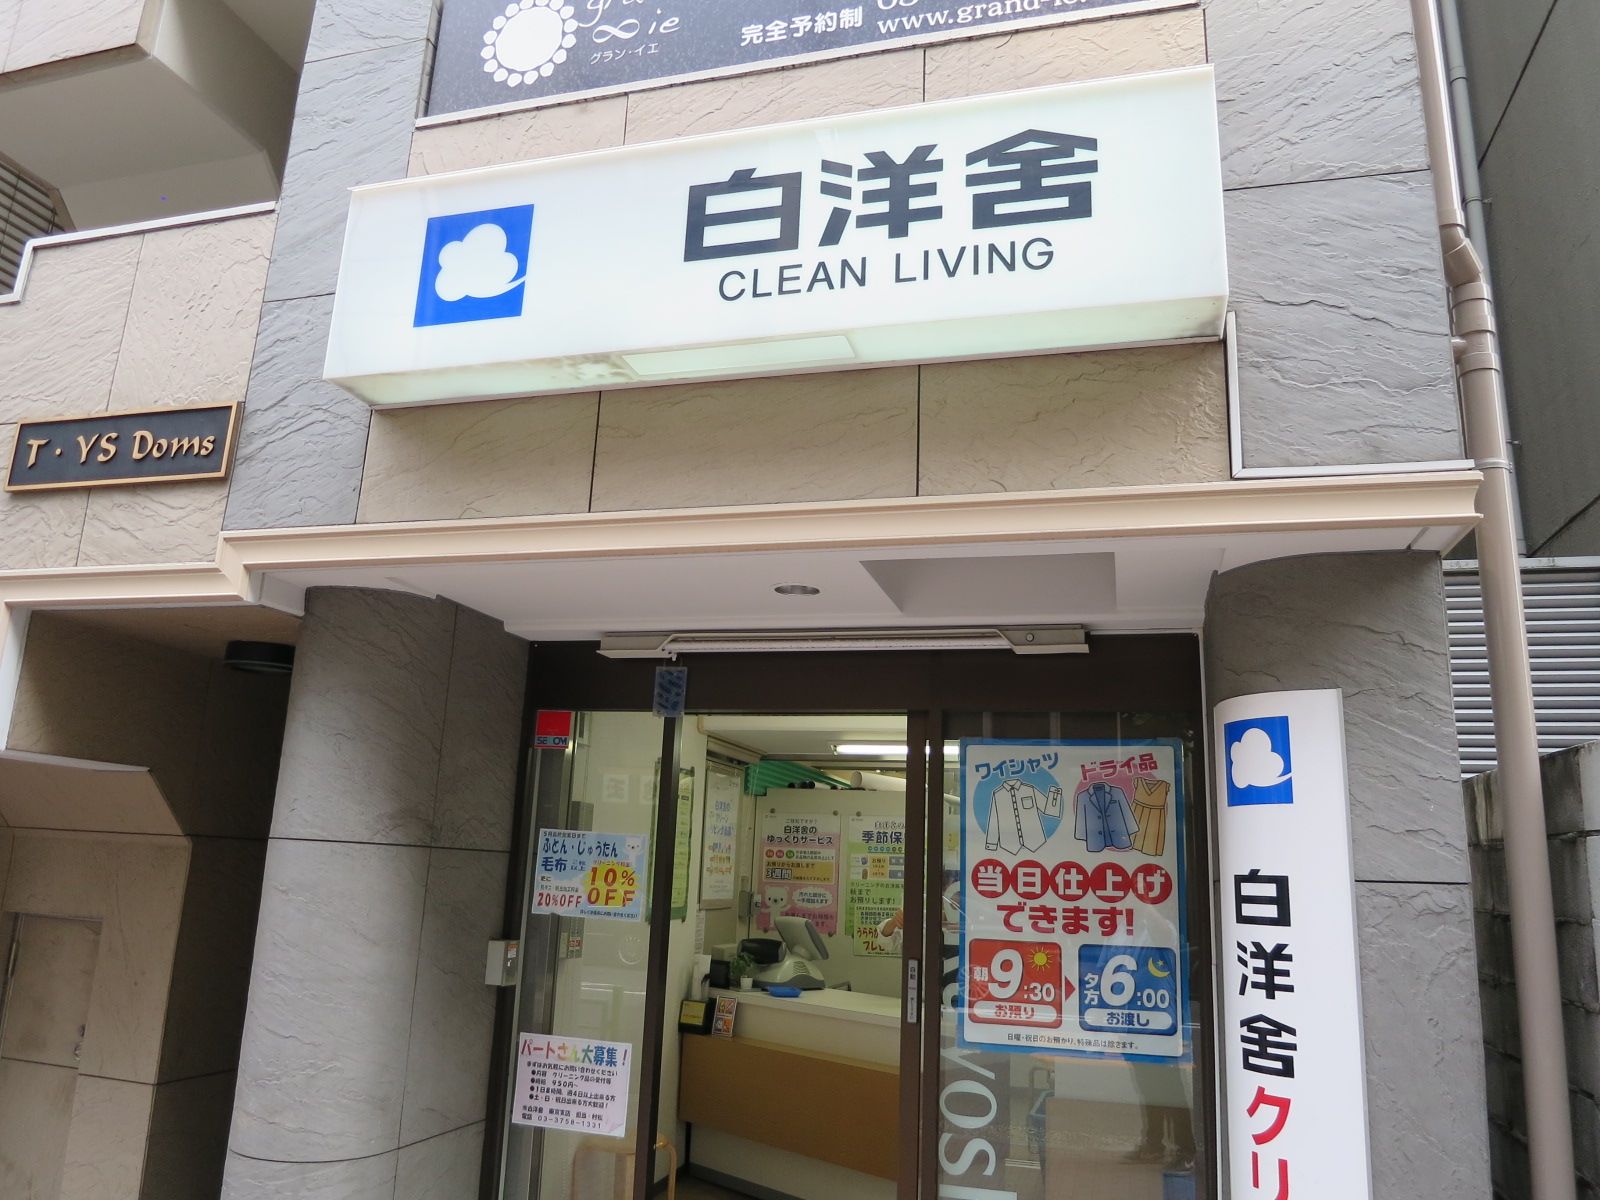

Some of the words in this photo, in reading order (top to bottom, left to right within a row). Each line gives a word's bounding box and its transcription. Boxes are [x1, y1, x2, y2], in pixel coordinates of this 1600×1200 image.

[740, 6, 863, 46] 完全予約制
[683, 129, 1098, 262] 白洋舎
[718, 256, 867, 301] CLEAN
[894, 237, 1055, 284] LIVING
[131, 430, 216, 460] Doms
[975, 752, 1059, 780] ワイシャツ
[1080, 752, 1158, 782] ドライ品
[784, 825, 817, 834] 白洋舎の
[861, 830, 904, 845] 季節保
[543, 838, 618, 858] ふとん・じゅうたん
[766, 835, 833, 845] ゆっくりサービス
[541, 856, 568, 872] 毛布
[590, 867, 636, 887] 10%
[977, 864, 1166, 899] 当日仕上げ
[537, 892, 582, 908] 20%OFF
[587, 887, 636, 907] OFF
[996, 901, 1134, 936] できます!
[973, 966, 989, 982] 朝
[1084, 973, 1099, 1005] 夕方
[1107, 1012, 1149, 1027] お渡し
